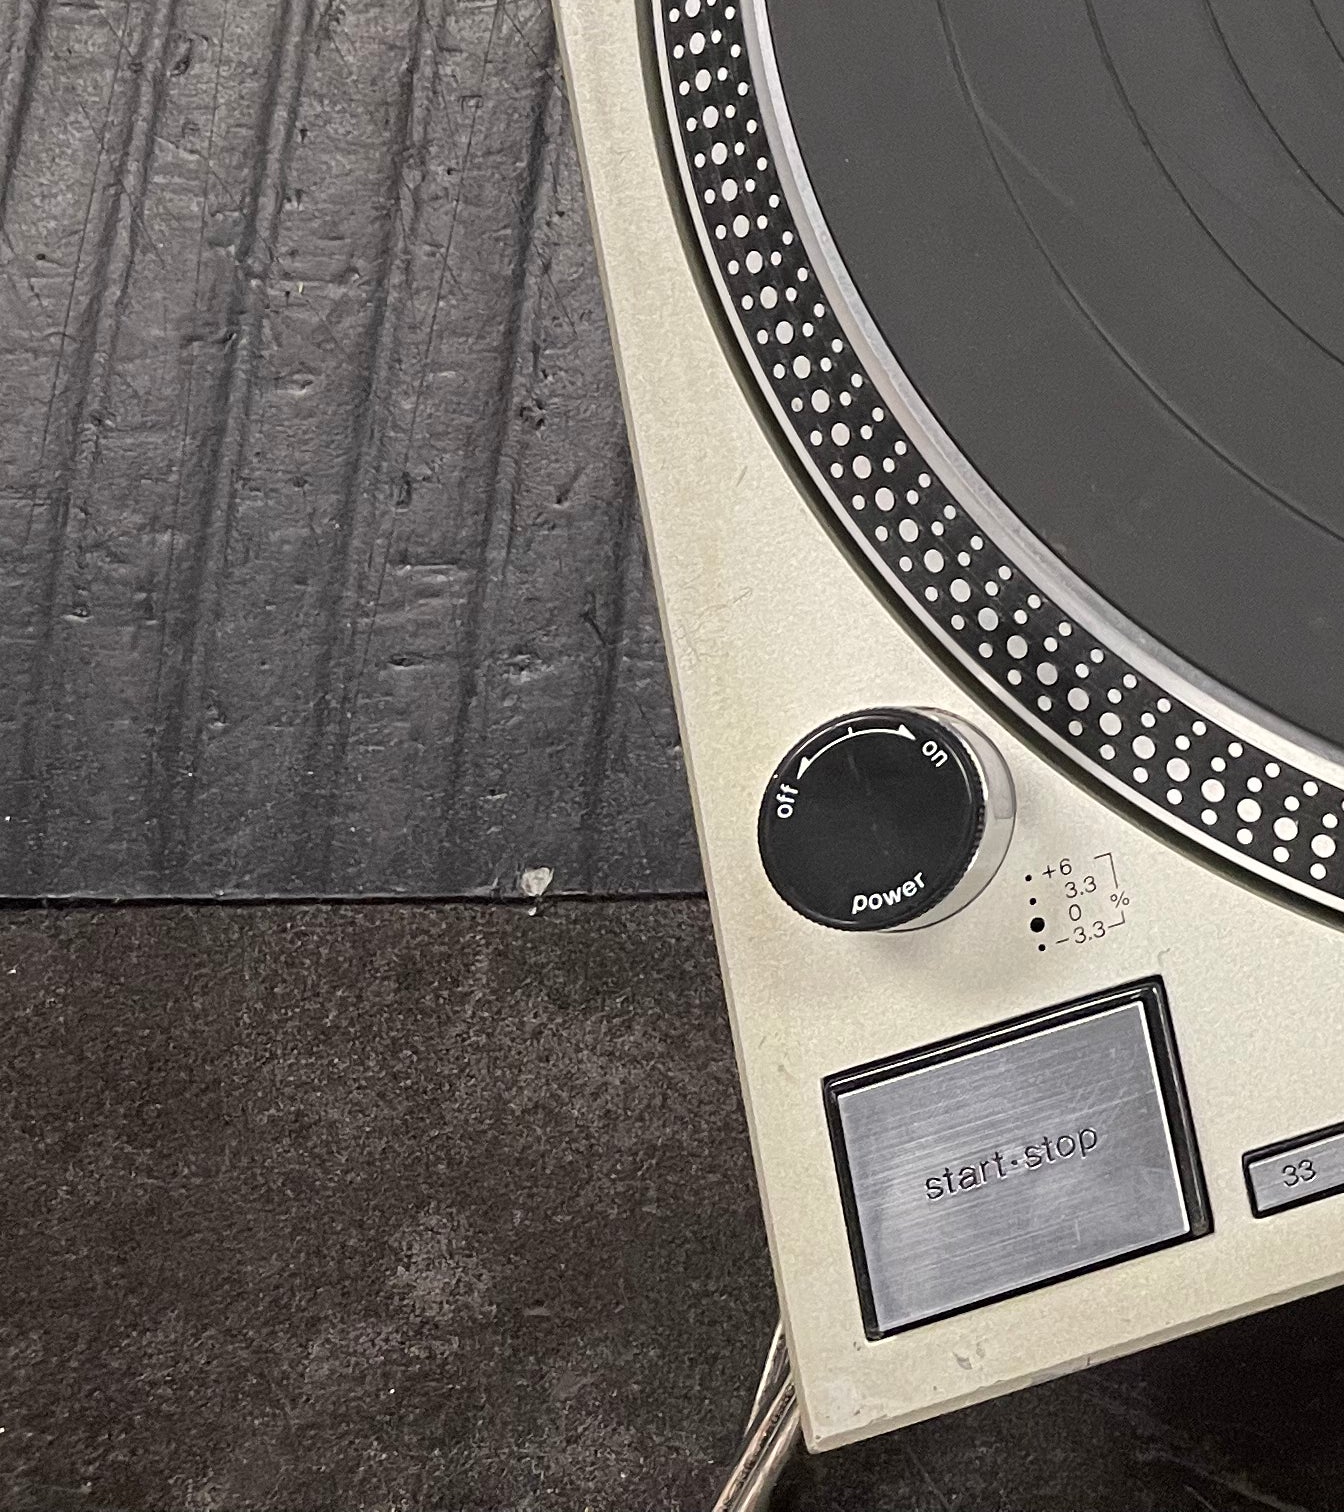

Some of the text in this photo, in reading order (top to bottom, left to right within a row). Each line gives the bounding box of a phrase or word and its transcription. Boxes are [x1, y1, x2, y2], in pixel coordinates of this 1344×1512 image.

[921, 740, 949, 768] on
[776, 783, 799, 819] off
[1041, 857, 1073, 879] +6
[851, 871, 926, 915] power
[1064, 875, 1097, 899] 3.3
[1109, 890, 1130, 909] %
[1068, 903, 1082, 922] 0
[1282, 1159, 1318, 1187] 33
